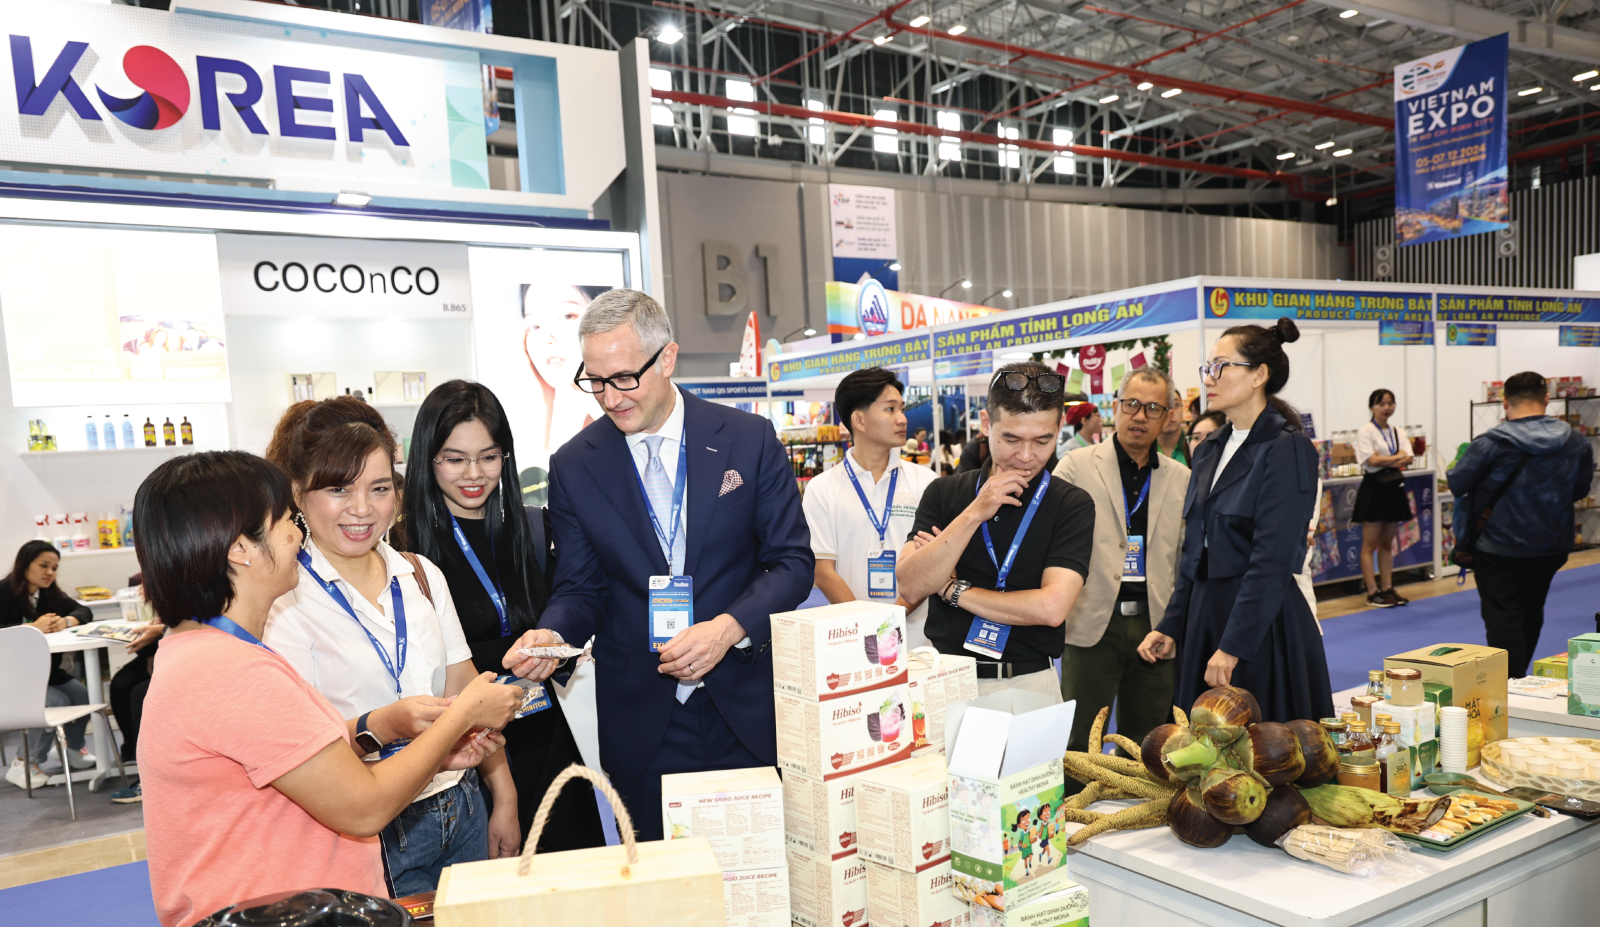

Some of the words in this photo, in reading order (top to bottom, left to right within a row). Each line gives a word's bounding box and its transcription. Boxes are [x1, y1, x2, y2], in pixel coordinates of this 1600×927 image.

[1407, 77, 1494, 113] VIETNAM
[1407, 95, 1495, 137] EXPO
[1415, 143, 1486, 168] 05-07.12.2024
[253, 260, 440, 296] COCOnCO
[701, 238, 779, 317] B1
[1234, 292, 1268, 307] KHU
[1272, 293, 1311, 308] GIAN
[1314, 291, 1356, 308] HÀNG
[1359, 295, 1405, 311] TRƯNG
[1408, 296, 1433, 311] BÀY
[1439, 295, 1466, 311] SẢN
[1469, 294, 1504, 311] PHẨM
[1507, 297, 1533, 312] TỈNH
[1535, 300, 1566, 314] LONG
[1567, 302, 1583, 314] AN
[901, 300, 928, 330] DA
[1297, 310, 1350, 319] PRODUCT
[1355, 311, 1400, 320] DISPLAY
[1404, 312, 1431, 322] AREA
[1453, 312, 1478, 321] LONG
[1481, 312, 1494, 321] AN
[1497, 313, 1541, 322] PROVINCE
[937, 331, 965, 349] SẢN
[970, 322, 1015, 344] PHẨM
[1019, 316, 1058, 336] TỈNH
[1062, 308, 1110, 329] LONG
[1115, 303, 1144, 320] AN
[935, 349, 949, 358] OF
[952, 344, 983, 356] LONG
[986, 341, 1001, 350] AN
[1006, 329, 1072, 347] PROVINCE
[782, 360, 802, 374] KHU
[804, 357, 829, 370] GIAN
[831, 350, 861, 366] HÀNG
[863, 344, 902, 360] TRƯNG
[904, 338, 930, 352] BÀY
[819, 364, 857, 375] PRODUCT
[860, 357, 897, 370] DISPLAY
[901, 353, 928, 363] AREA
[726, 386, 747, 394] SPORTS
[828, 625, 859, 640] Hibiso
[832, 705, 862, 721] Hibiso
[922, 791, 949, 809] Hibiso
[757, 872, 778, 880] RECIPE
[844, 863, 866, 880] Hibis
[930, 872, 952, 889] Hibis
[1031, 917, 1053, 927] HEALTHY
[1054, 912, 1069, 921] MONA
